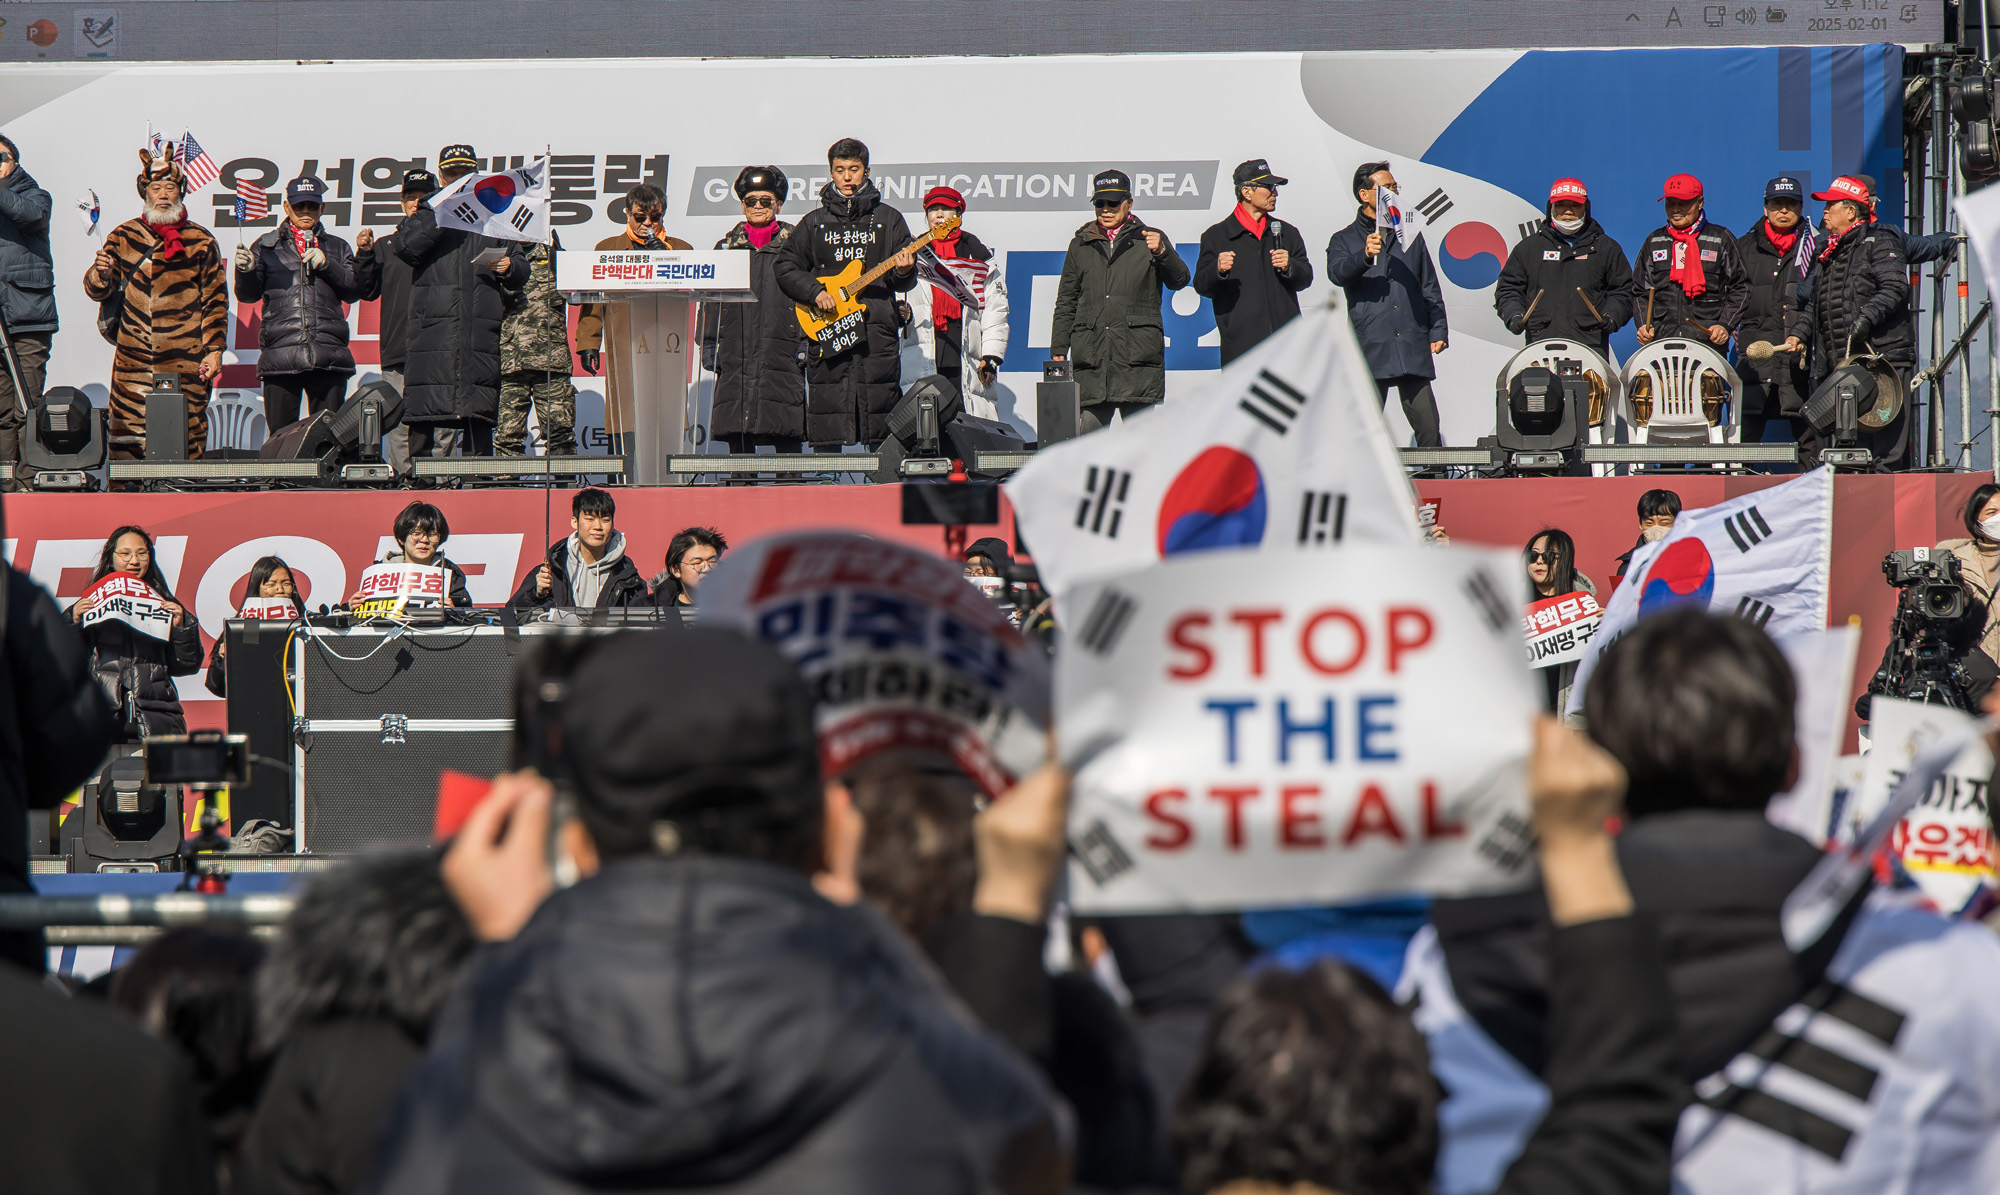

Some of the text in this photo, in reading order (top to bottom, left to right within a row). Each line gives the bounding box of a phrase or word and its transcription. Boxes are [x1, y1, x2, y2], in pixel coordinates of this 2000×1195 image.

[1862, 0, 1888, 10] 1:12
[1808, 17, 1887, 31] 2025-02-01
[875, 174, 1075, 199] NIFICATION
[1086, 173, 1199, 197] REA
[1775, 183, 1793, 191] ROTC
[824, 231, 876, 244] 나는 공산당이
[599, 255, 624, 263] 윤석열
[625, 255, 650, 263] 대통령
[834, 247, 864, 261] 싫어요
[592, 264, 715, 280] 탄핵반대 국민대회
[818, 310, 864, 342] 나는 공산당이
[832, 331, 859, 352] 싫어요
[1918, 550, 1926, 560] 3
[361, 571, 445, 597] 탄핵무효
[86, 598, 172, 624] 이재명 구속
[1521, 594, 1600, 637] 탄핵무효
[1167, 606, 1436, 680] STOP
[1526, 629, 1575, 662] 이재명
[1204, 695, 1400, 765] THE
[1144, 779, 1467, 850] STEAL
